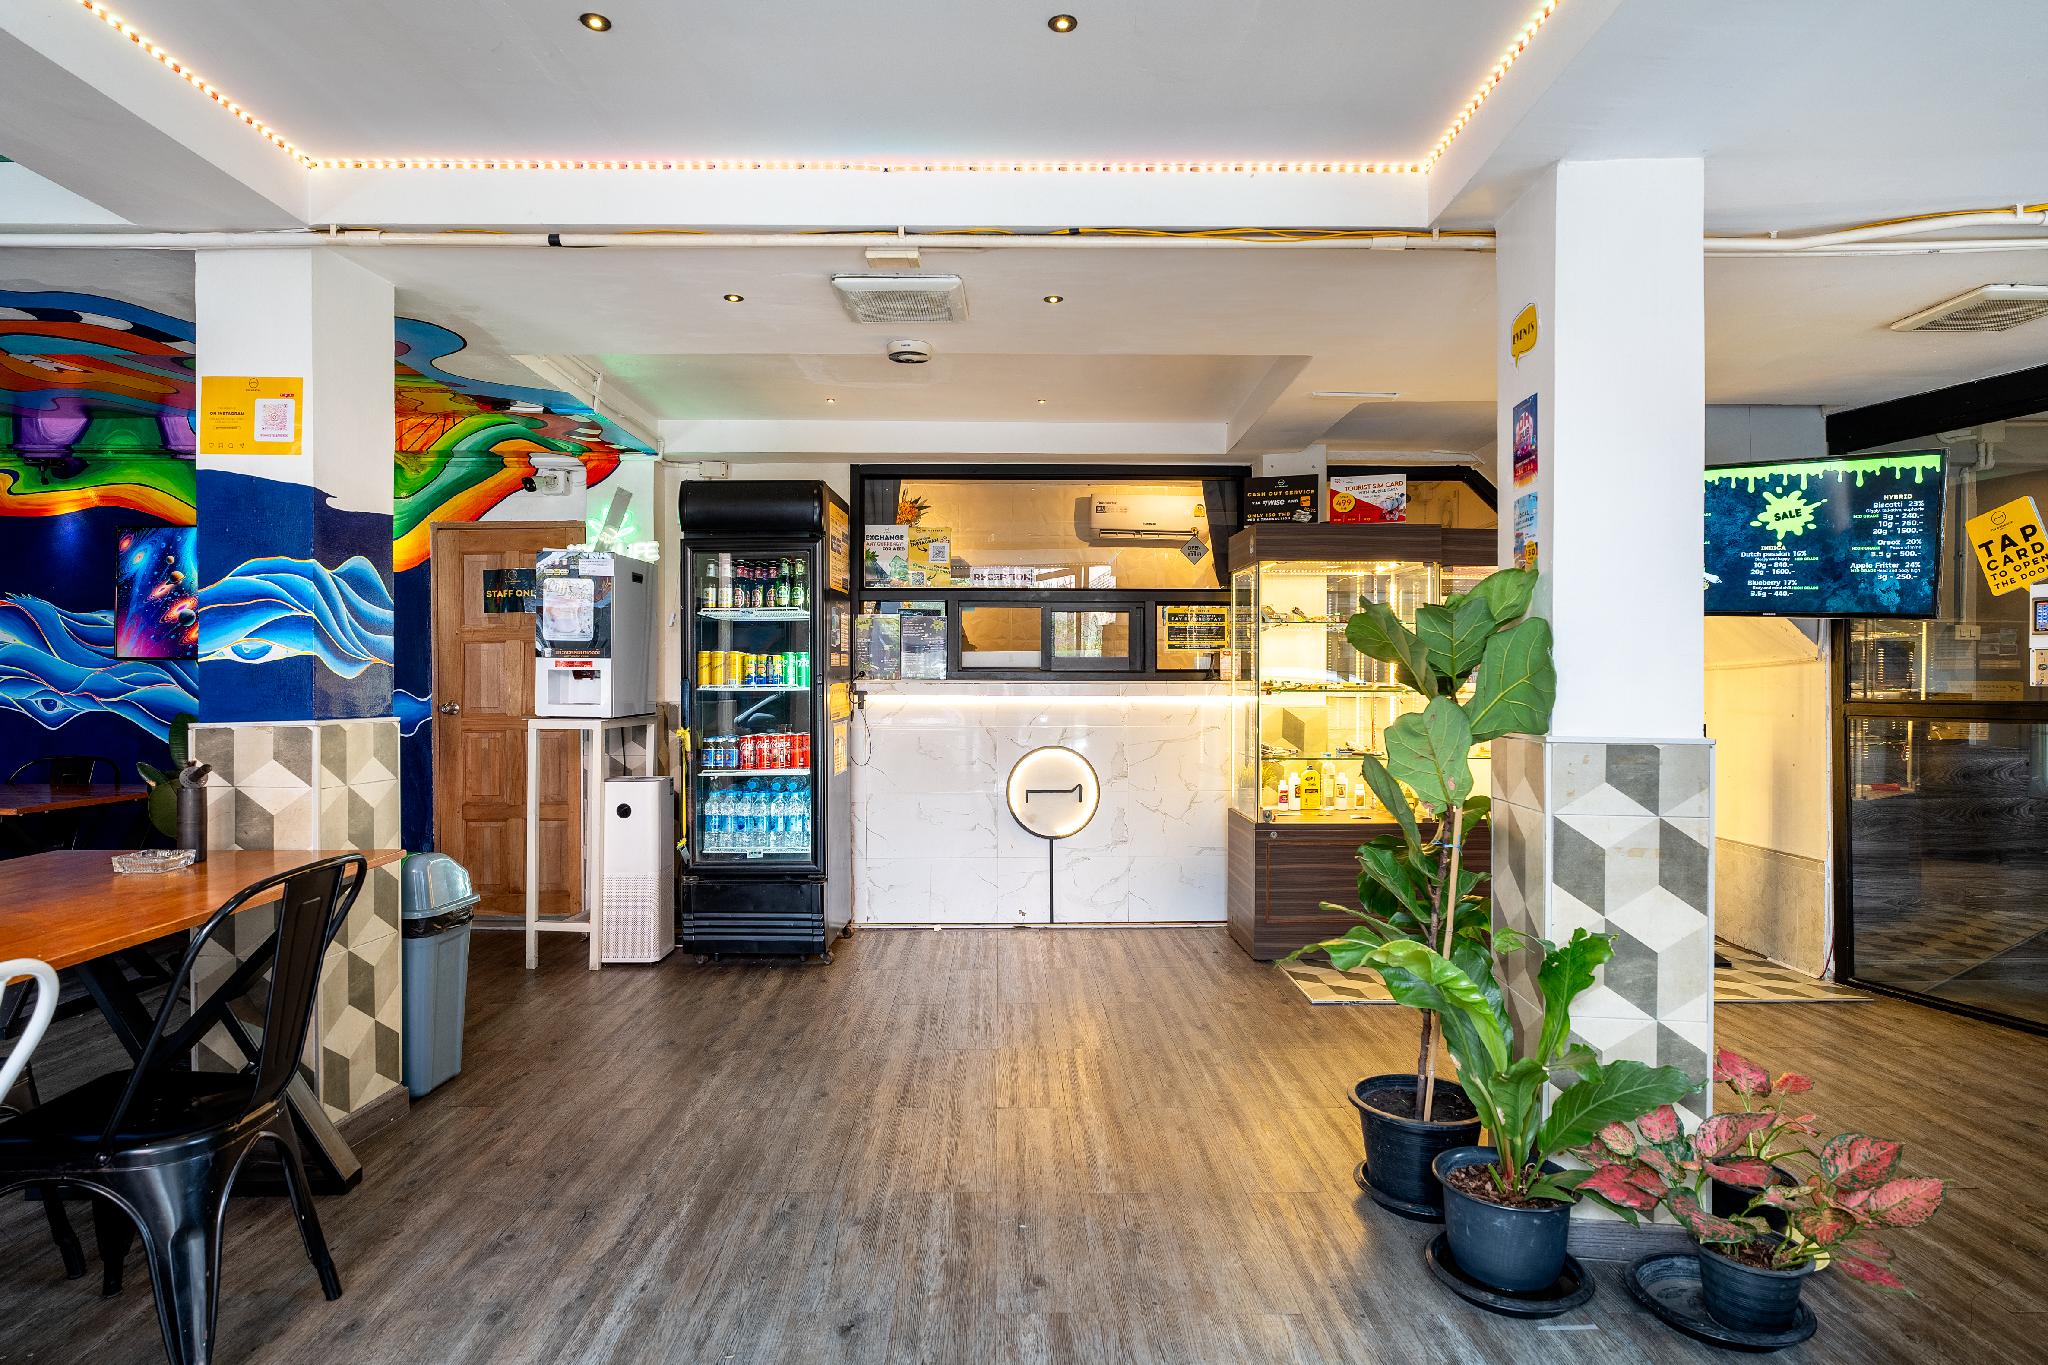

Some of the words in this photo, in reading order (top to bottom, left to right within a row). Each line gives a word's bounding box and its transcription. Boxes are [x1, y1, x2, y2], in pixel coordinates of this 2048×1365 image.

[1774, 508, 1802, 522] SALE
[1878, 520, 1893, 528] 10g
[1978, 525, 2037, 557] TAP
[1986, 541, 2045, 572] CARD
[973, 573, 1031, 581] RECEPTION
[1990, 570, 2008, 581] TO
[1994, 577, 2017, 590] THE
[486, 590, 514, 598] STAFF
[515, 589, 536, 597] ONL
